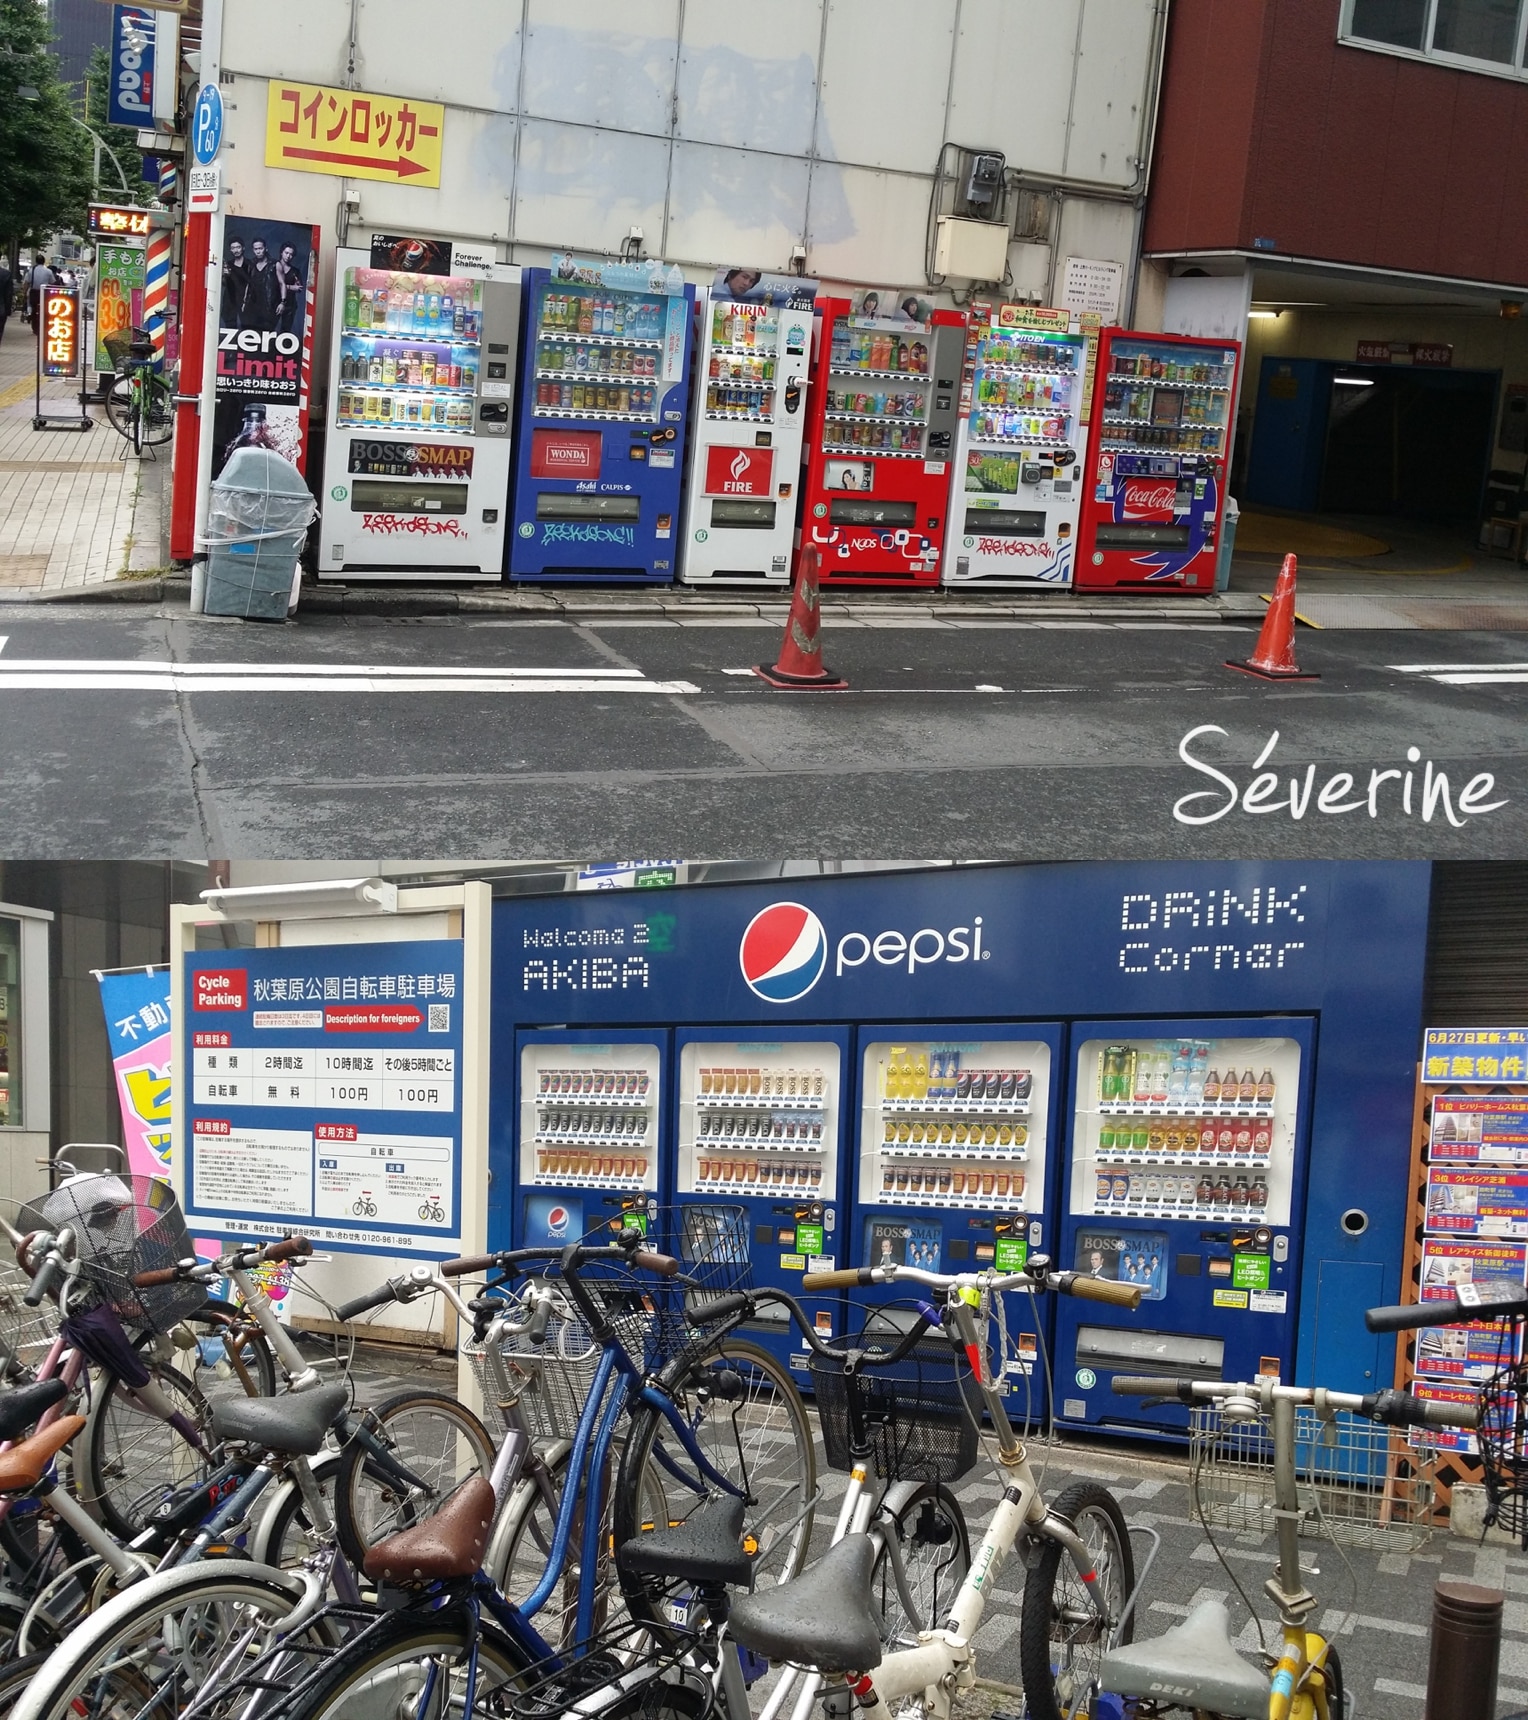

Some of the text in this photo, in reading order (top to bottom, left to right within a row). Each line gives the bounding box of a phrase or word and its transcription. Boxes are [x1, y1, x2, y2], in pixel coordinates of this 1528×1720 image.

[280, 89, 438, 152] コインロッカー
[198, 103, 211, 153] P
[205, 129, 215, 152] 60
[455, 253, 482, 261] Forever
[454, 260, 492, 270] Challenge.
[764, 283, 802, 294] 心に火を。
[730, 304, 767, 317] KIRIN
[793, 302, 813, 311] FIRE
[47, 298, 72, 362] のお店
[218, 328, 300, 354] zero
[1020, 334, 1046, 343] ITO EN
[217, 351, 297, 380] Limit
[216, 376, 297, 391] 思いっきり味わおう
[352, 442, 406, 462] BOSS
[418, 446, 472, 466] SMAP
[551, 449, 585, 459] WONDA
[576, 481, 597, 490] Asahi
[600, 483, 624, 491] CALPIS
[723, 481, 753, 493] FIRE
[523, 927, 625, 948] Welcome
[836, 915, 984, 977] pepsi
[1119, 942, 1305, 973] Corner
[523, 956, 649, 991] AKIBA
[198, 975, 230, 991] Cycle
[253, 974, 456, 1002] 秋葉原公園自転車駐車場
[198, 993, 242, 1008] Parking
[326, 1014, 420, 1026] Description for foreigners
[195, 1034, 228, 1046] 利用料金
[265, 1057, 303, 1070] 2時間迄
[326, 1057, 373, 1071] 10時間迄
[384, 1058, 452, 1072] その後5時間ごと
[1426, 1056, 1524, 1077] 新築物件
[208, 1084, 238, 1097] 自転車
[330, 1087, 368, 1101] 100円
[399, 1088, 438, 1103] 100円
[195, 1121, 228, 1133] 利用規約
[318, 1127, 355, 1140] 使用方法
[370, 1147, 394, 1157] 自転車
[361, 1234, 413, 1246] 0120-961-895
[875, 1226, 940, 1240] BOSS SMAP
[1083, 1237, 1160, 1253] BOSS SMAP
[674, 1608, 684, 1622] 10
[1149, 1682, 1194, 1697] DEKI
